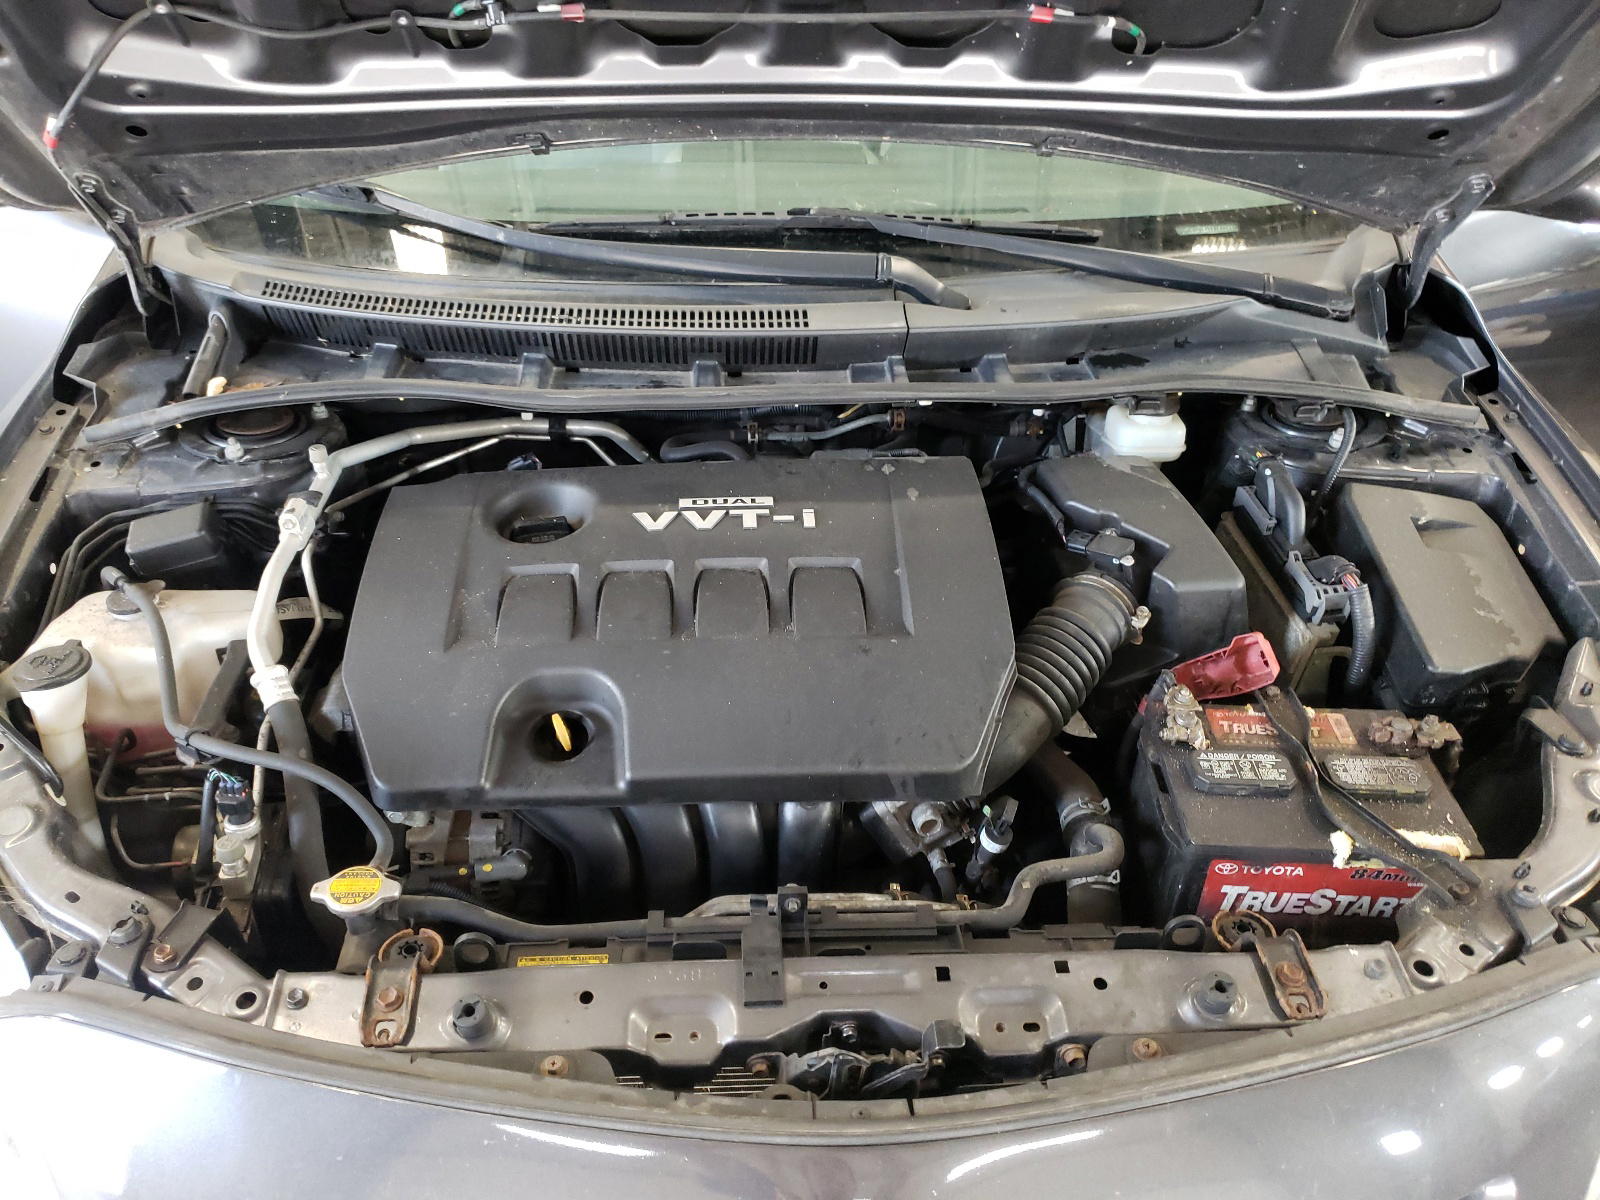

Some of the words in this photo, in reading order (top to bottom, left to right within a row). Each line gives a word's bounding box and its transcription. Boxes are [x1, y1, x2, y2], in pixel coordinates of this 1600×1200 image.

[632, 508, 816, 532] VVT-i
[1207, 752, 1240, 760] DANGER
[1242, 865, 1304, 877] TOYOTA
